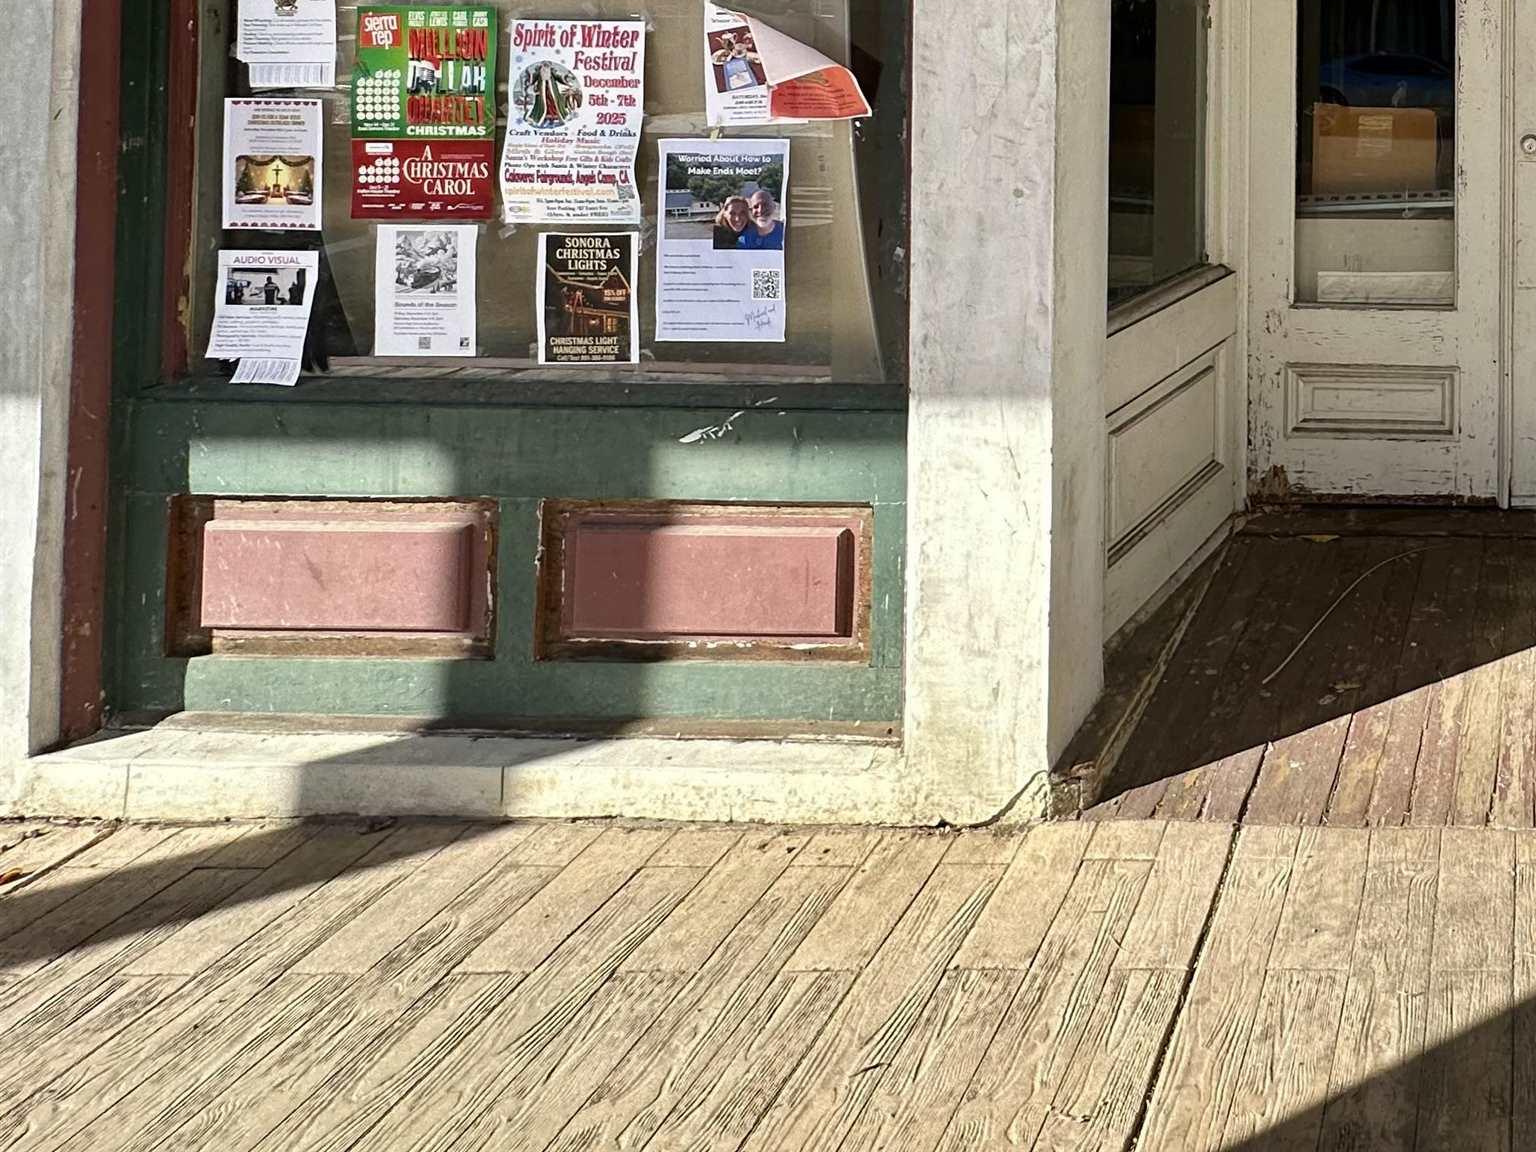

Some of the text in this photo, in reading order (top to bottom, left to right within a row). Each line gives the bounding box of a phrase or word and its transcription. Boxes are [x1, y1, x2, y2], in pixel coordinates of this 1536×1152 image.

[364, 12, 397, 32] sierra
[372, 30, 392, 49] rep
[513, 22, 640, 52] Spirit of Winter
[572, 50, 637, 71] Festival
[407, 60, 486, 94] DLLAR
[583, 75, 641, 89] December
[588, 94, 636, 108] 5th 7th
[596, 112, 627, 126] 2025
[406, 125, 486, 136] CHRISTMAS
[509, 129, 637, 138] Craft Vendors Food & Drinks
[422, 145, 432, 161] A
[678, 154, 771, 163] Worried About How to
[402, 157, 489, 184] CHRISTMAS
[688, 167, 763, 176] Make Ends Meet?
[619, 171, 630, 184] CA
[423, 179, 475, 196] CAROL
[565, 237, 610, 248] SONORA
[233, 256, 300, 264] AUDIO VISUAL
[556, 248, 620, 259] CHRISTMAS
[567, 259, 607, 270] LIGHTS
[549, 336, 617, 345] CHRISTMAS LIGHT
[588, 346, 619, 354] SERVICE
